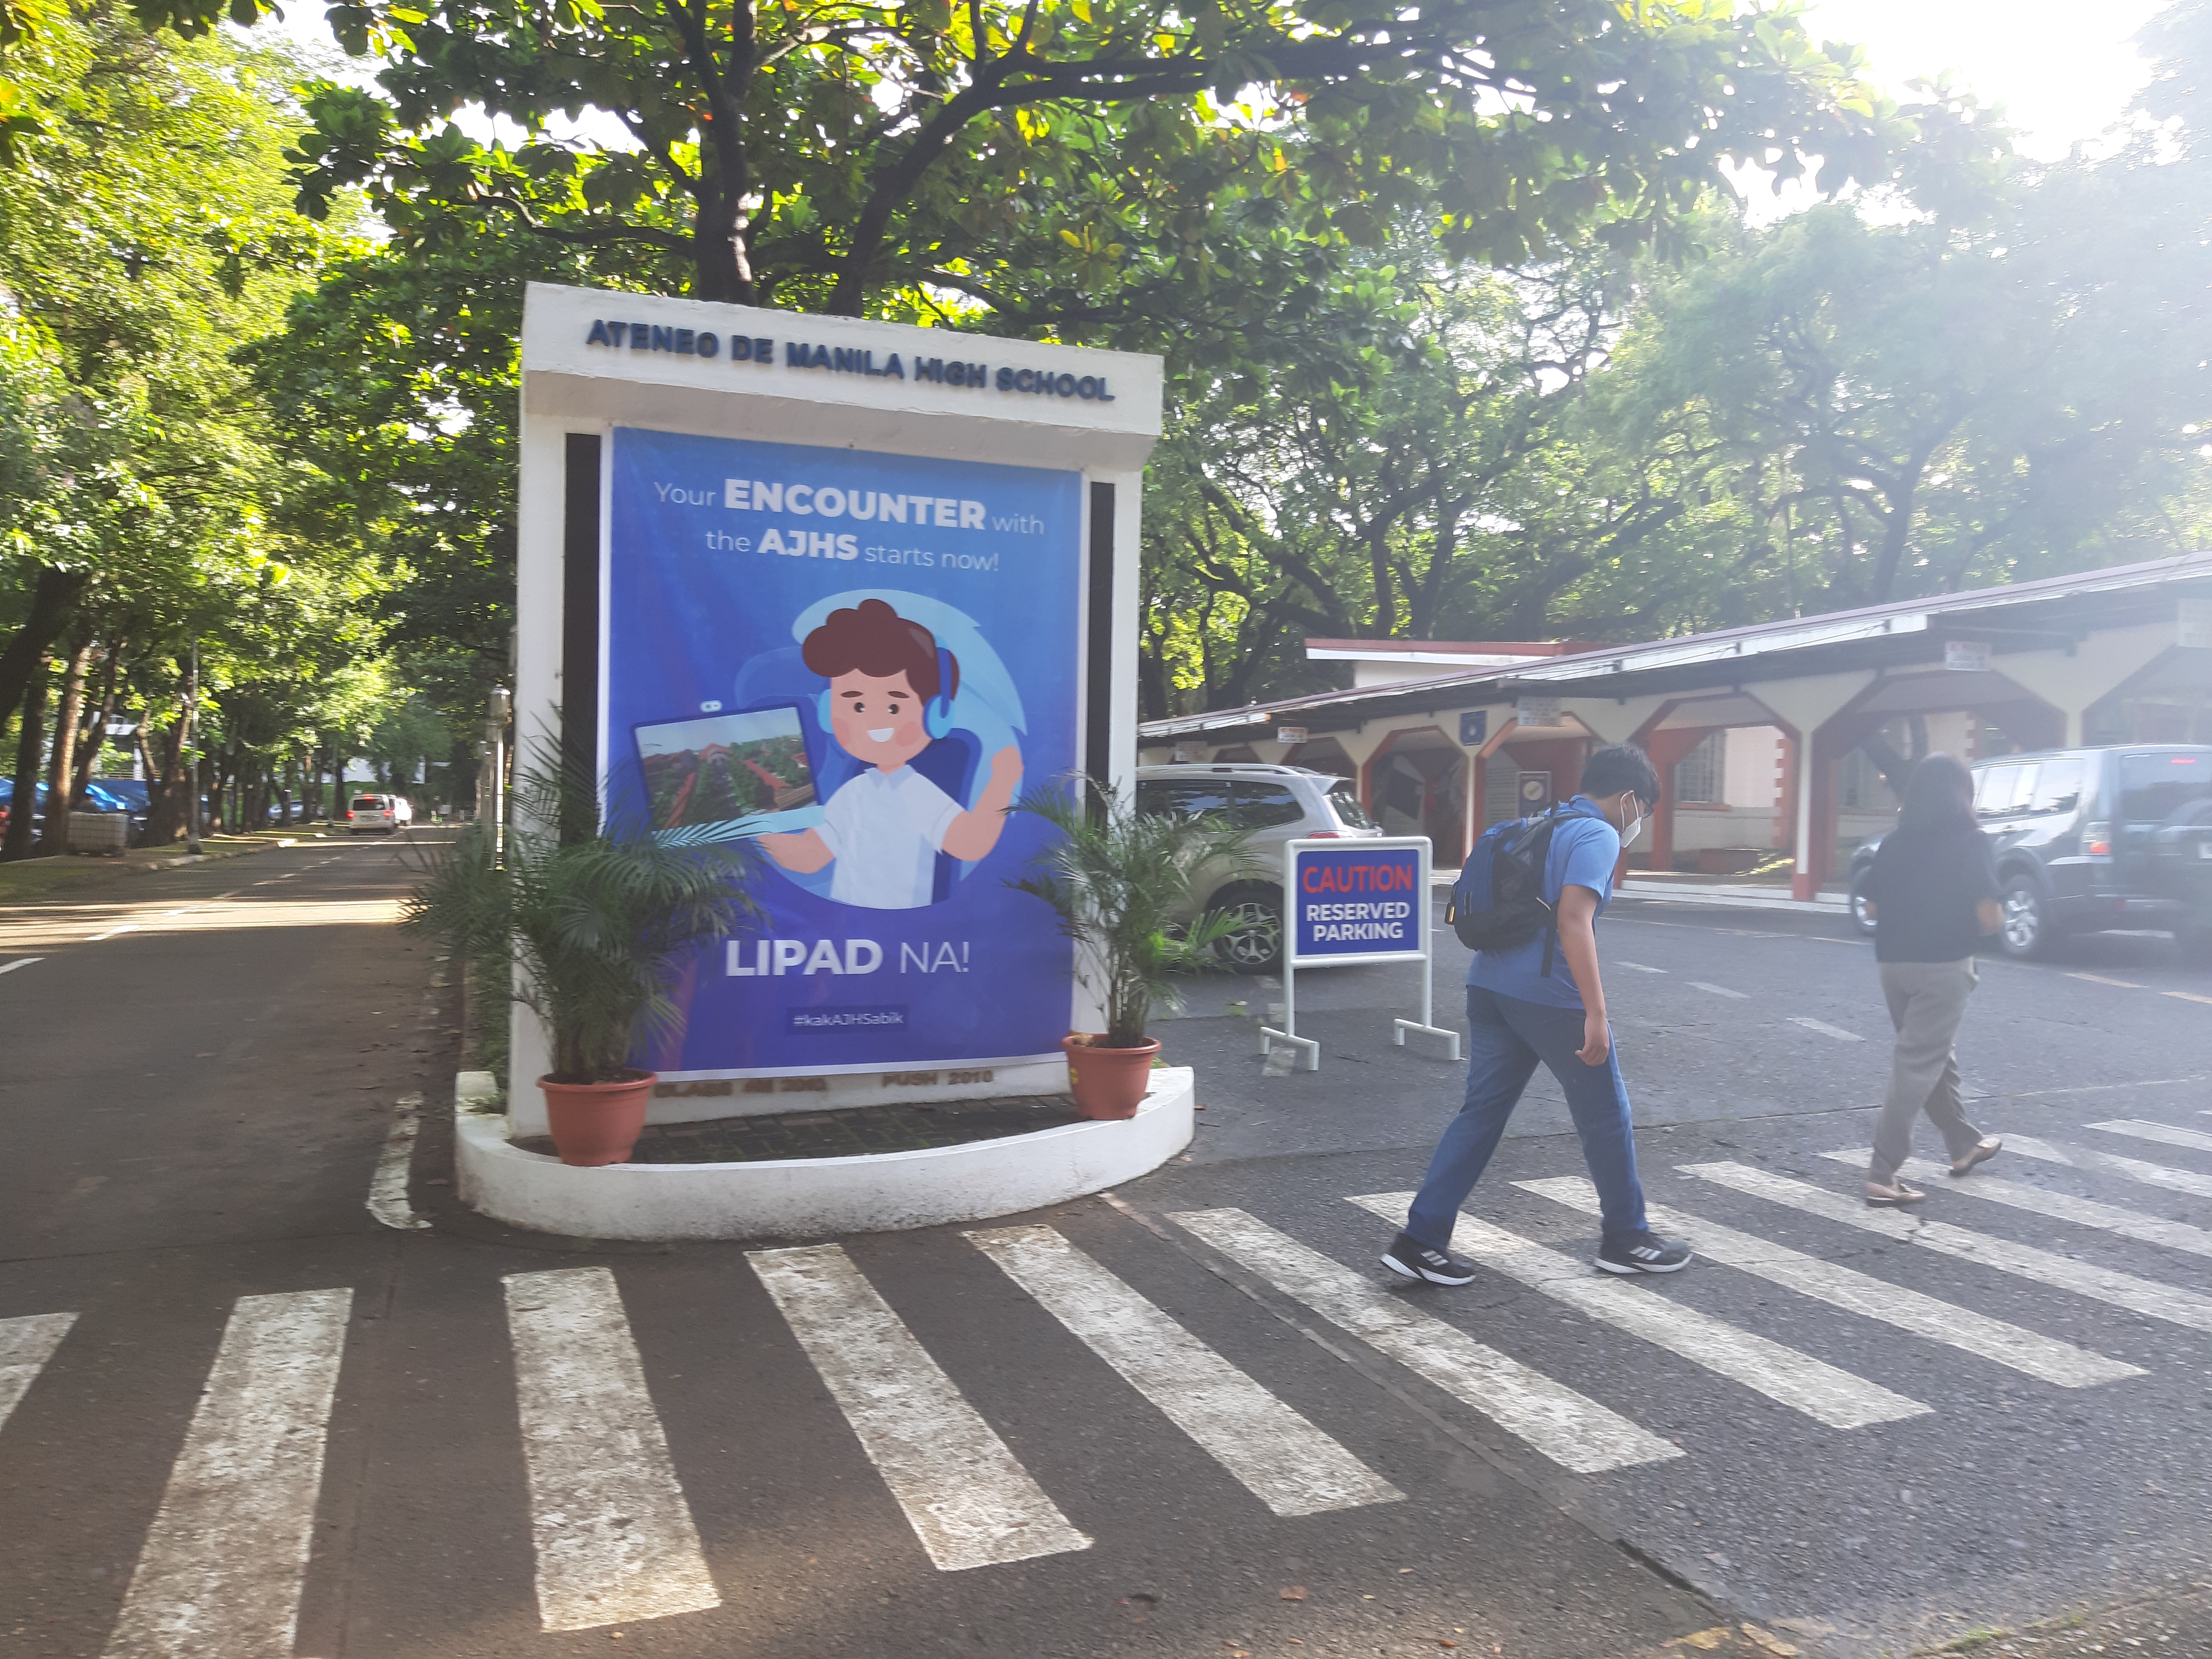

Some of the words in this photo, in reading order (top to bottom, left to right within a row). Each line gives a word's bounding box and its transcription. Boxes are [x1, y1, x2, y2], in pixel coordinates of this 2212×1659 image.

[585, 319, 720, 358] ATENEO
[731, 335, 774, 364] DE
[786, 342, 904, 379] MANILA
[914, 356, 987, 388] HIGH
[995, 367, 1116, 401] SCHOOL
[654, 482, 717, 506] Your
[724, 478, 986, 530] ENCOUNTER
[992, 514, 1044, 534] with
[705, 530, 751, 552] the
[757, 528, 859, 561] AJHS
[864, 546, 935, 567] starts
[942, 553, 999, 572] now!
[1303, 865, 1413, 894] CAUTION
[1306, 902, 1411, 921] RESERVED
[1313, 922, 1404, 942] PARKING
[726, 939, 884, 976] LIPAD
[900, 941, 970, 973] NA!
[882, 1072, 938, 1087] PUSH
[949, 1070, 994, 1085] 2010
